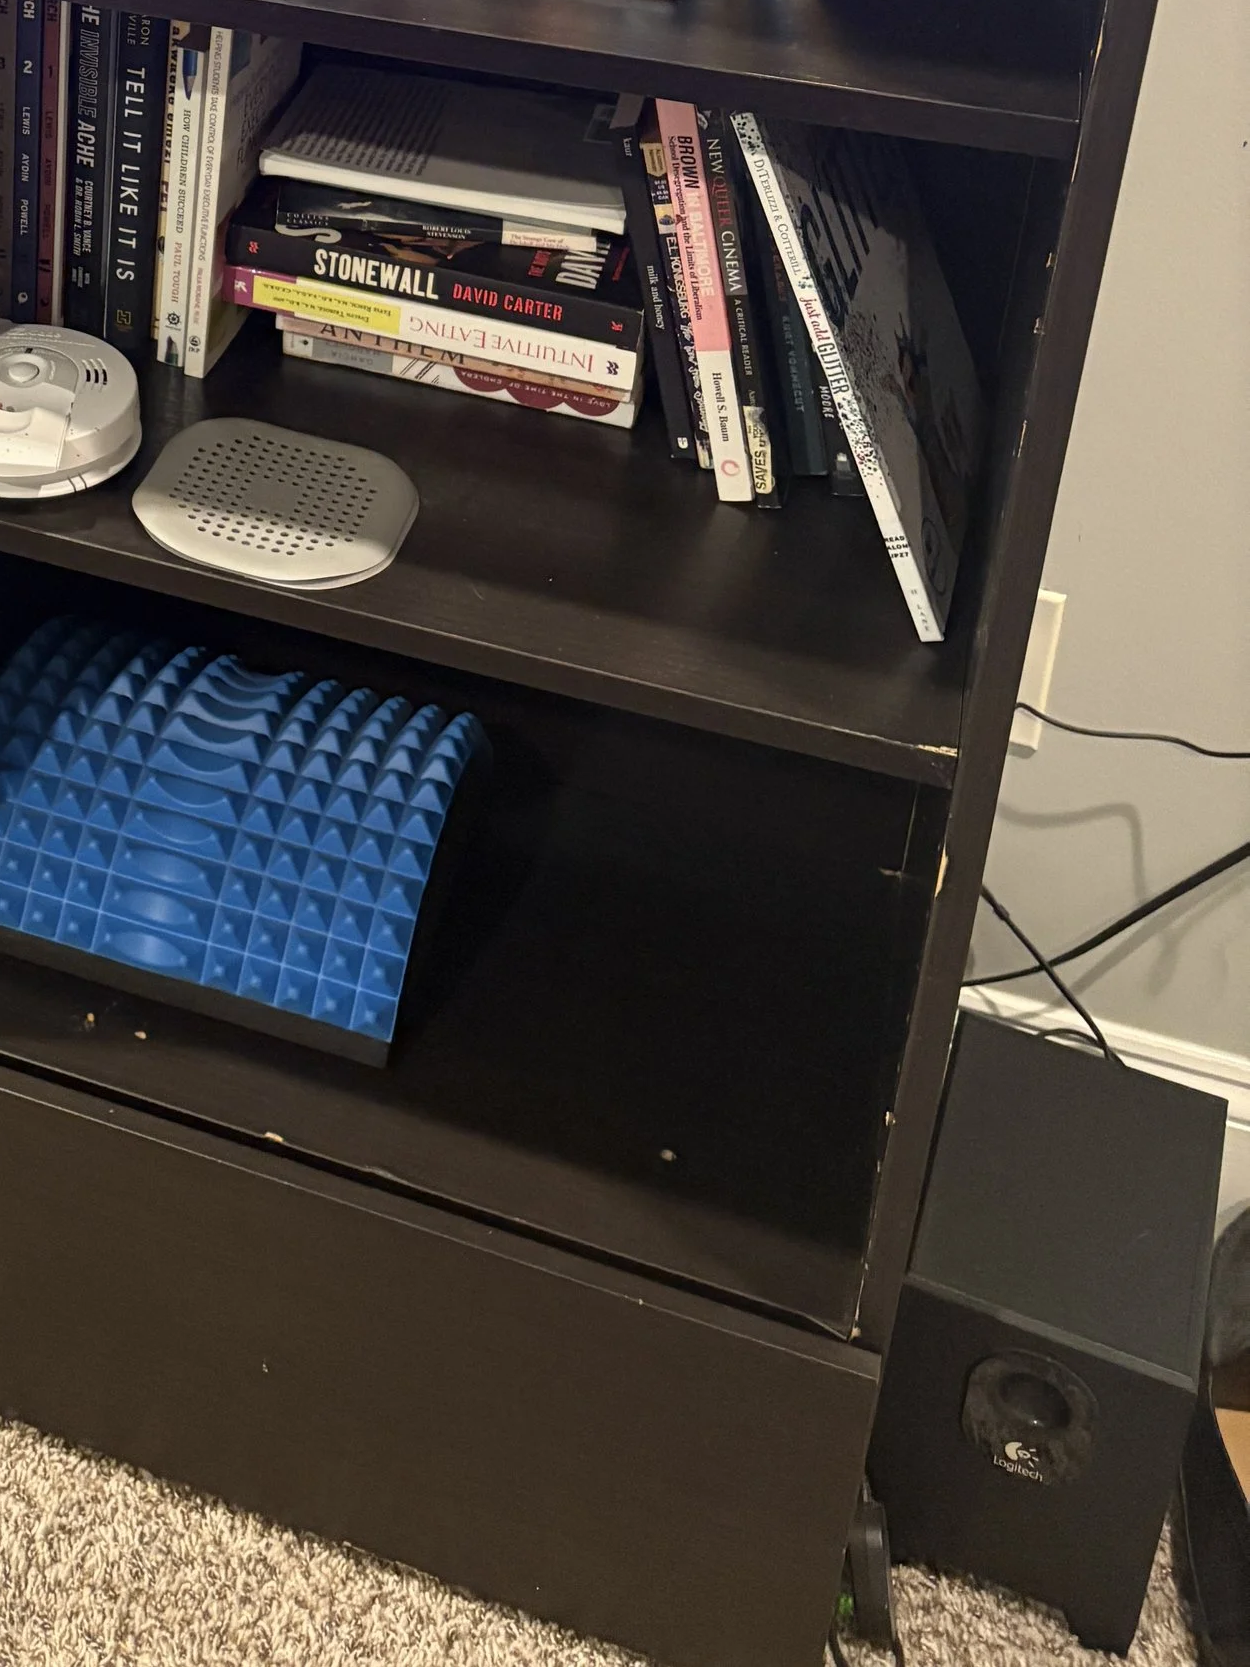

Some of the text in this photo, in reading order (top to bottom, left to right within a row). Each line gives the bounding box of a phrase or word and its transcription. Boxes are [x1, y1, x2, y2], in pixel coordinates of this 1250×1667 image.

[22, 60, 33, 74] 2
[76, 30, 100, 168] INVISIBLE ACHE
[19, 106, 31, 236] LEWIS AYDIN POWELL
[115, 67, 146, 282] TELL IT LIKE IT IS
[175, 109, 192, 234] HOW CHILDREN SUCCEED
[82, 180, 94, 221] COURTNEY
[677, 135, 715, 298] BROWN BALTIMORE
[706, 137, 743, 292] NEW QUEER CINEMA
[422, 224, 471, 235] ROBERT LOUIS
[426, 231, 466, 240] STEVENSON
[776, 223, 802, 277] COTTERILL
[170, 241, 183, 304] PAUL TOUGH
[313, 247, 440, 301] STONEWALL
[452, 282, 563, 322] DAVID CARTER
[653, 303, 666, 330] honey
[410, 316, 487, 349] EATING
[490, 334, 595, 374] INTUITIVE
[815, 340, 851, 395] GLITTER
[460, 370, 504, 386] CHOLERA
[526, 385, 548, 396] TIME
[550, 390, 569, 400] THE
[587, 396, 611, 409] LOVE
[712, 372, 730, 443] Howell Baum
[819, 385, 835, 420] MOORE
[755, 449, 767, 491] SAVES
[992, 1454, 1044, 1484] Logitech
